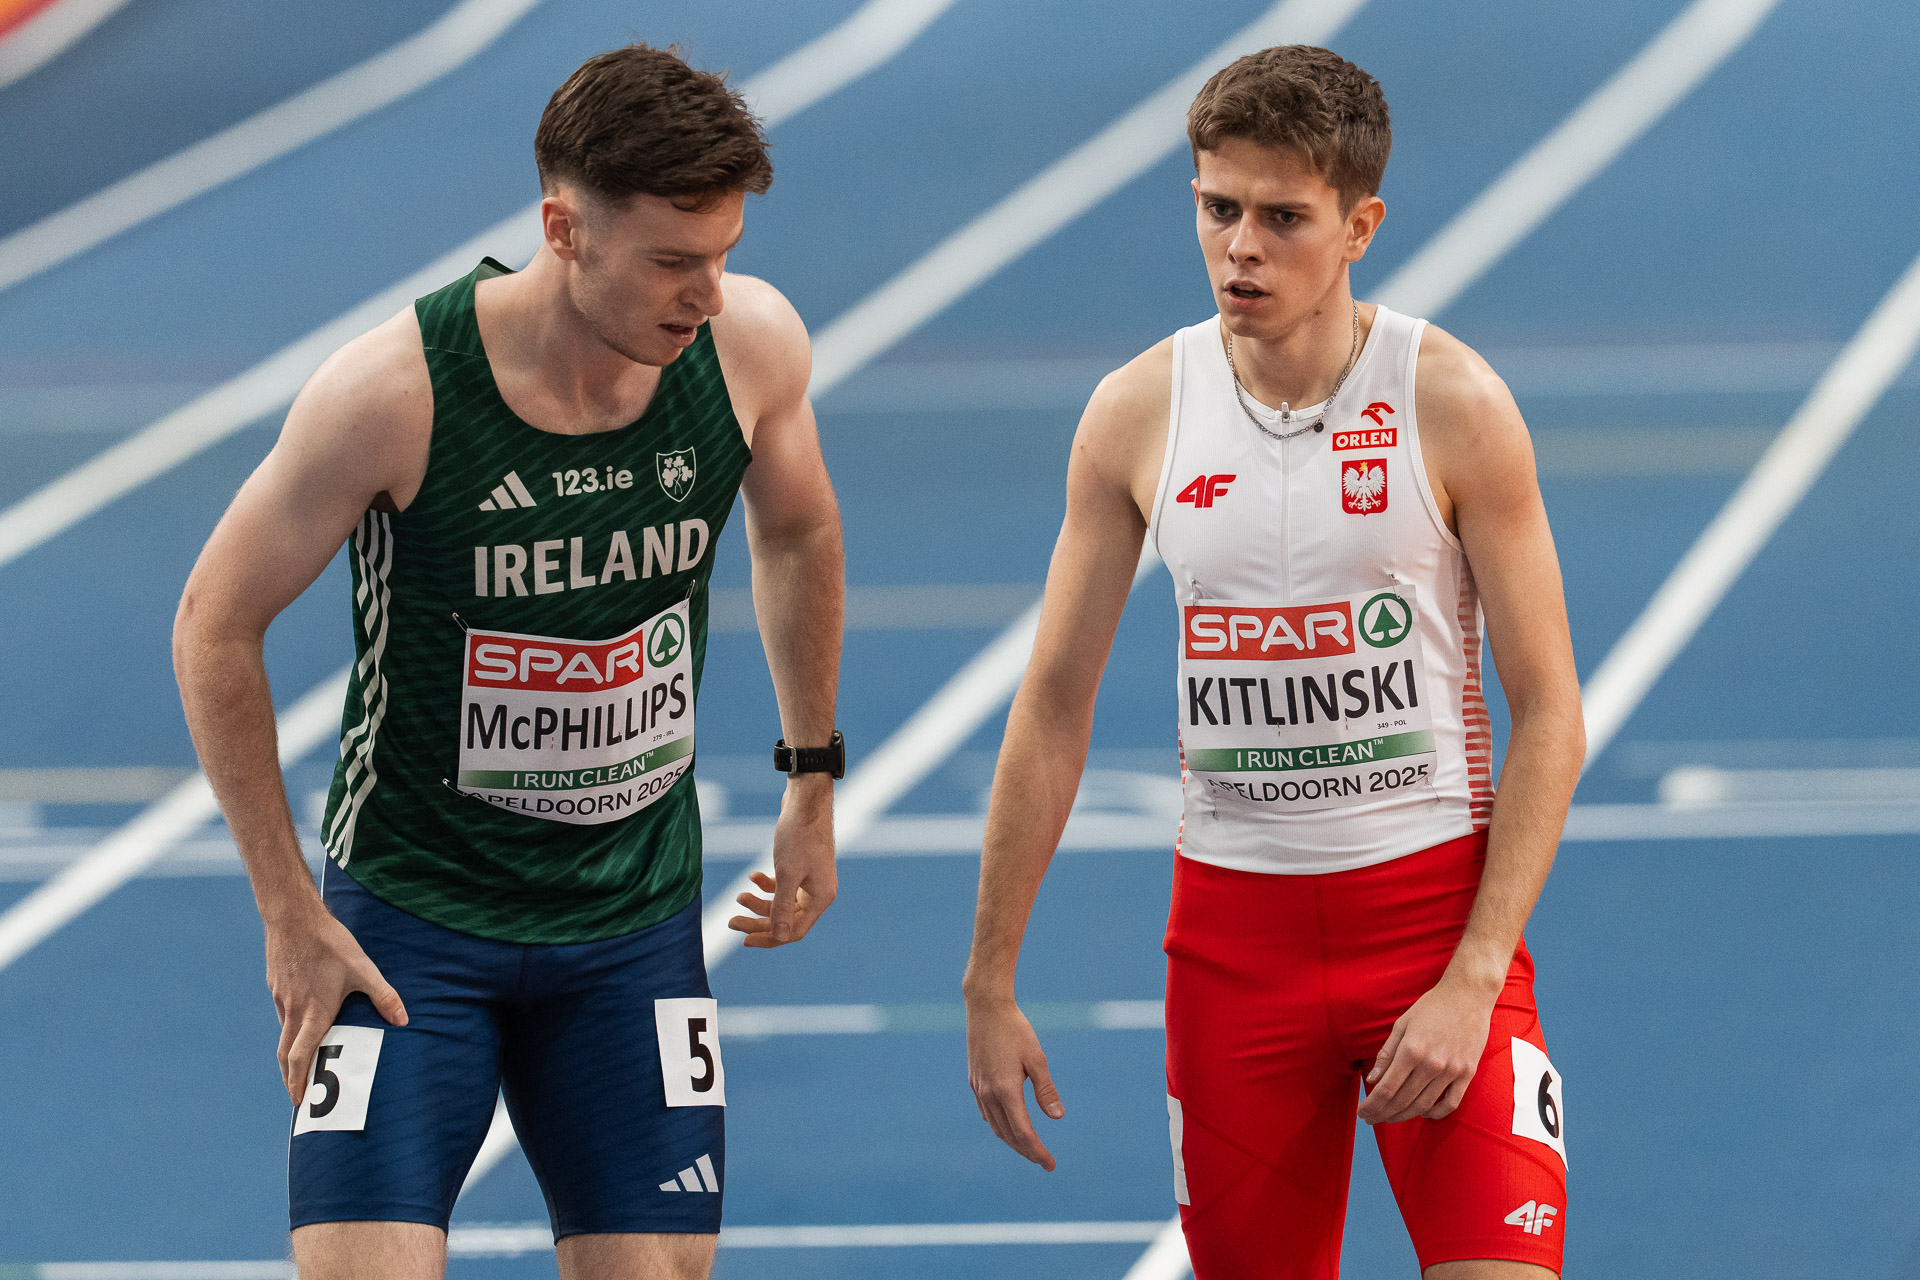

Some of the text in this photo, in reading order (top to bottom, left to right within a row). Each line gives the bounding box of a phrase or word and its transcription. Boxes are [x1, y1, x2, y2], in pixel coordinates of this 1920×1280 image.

[1335, 430, 1393, 448] ORLEN
[551, 465, 634, 497] 123.ie
[1175, 474, 1237, 509] 4F
[474, 518, 710, 598] IRELAND
[1190, 610, 1349, 653] SPAR
[474, 641, 641, 685] SPAR
[466, 672, 687, 751] McPHILLIPS
[1187, 659, 1419, 726] KITLINSKI
[1376, 722, 1389, 730] 349
[1393, 719, 1407, 727] POL
[1236, 751, 1242, 769] I
[1248, 750, 1293, 768] RUN
[512, 773, 519, 788] I
[524, 772, 574, 788] RUN
[637, 765, 685, 803] 2025
[1207, 763, 1429, 802] APELDOORN 2025
[687, 1017, 716, 1093] 5
[309, 1044, 344, 1119] 5
[1537, 1070, 1560, 1139] 6
[1503, 1199, 1559, 1236] 4F
